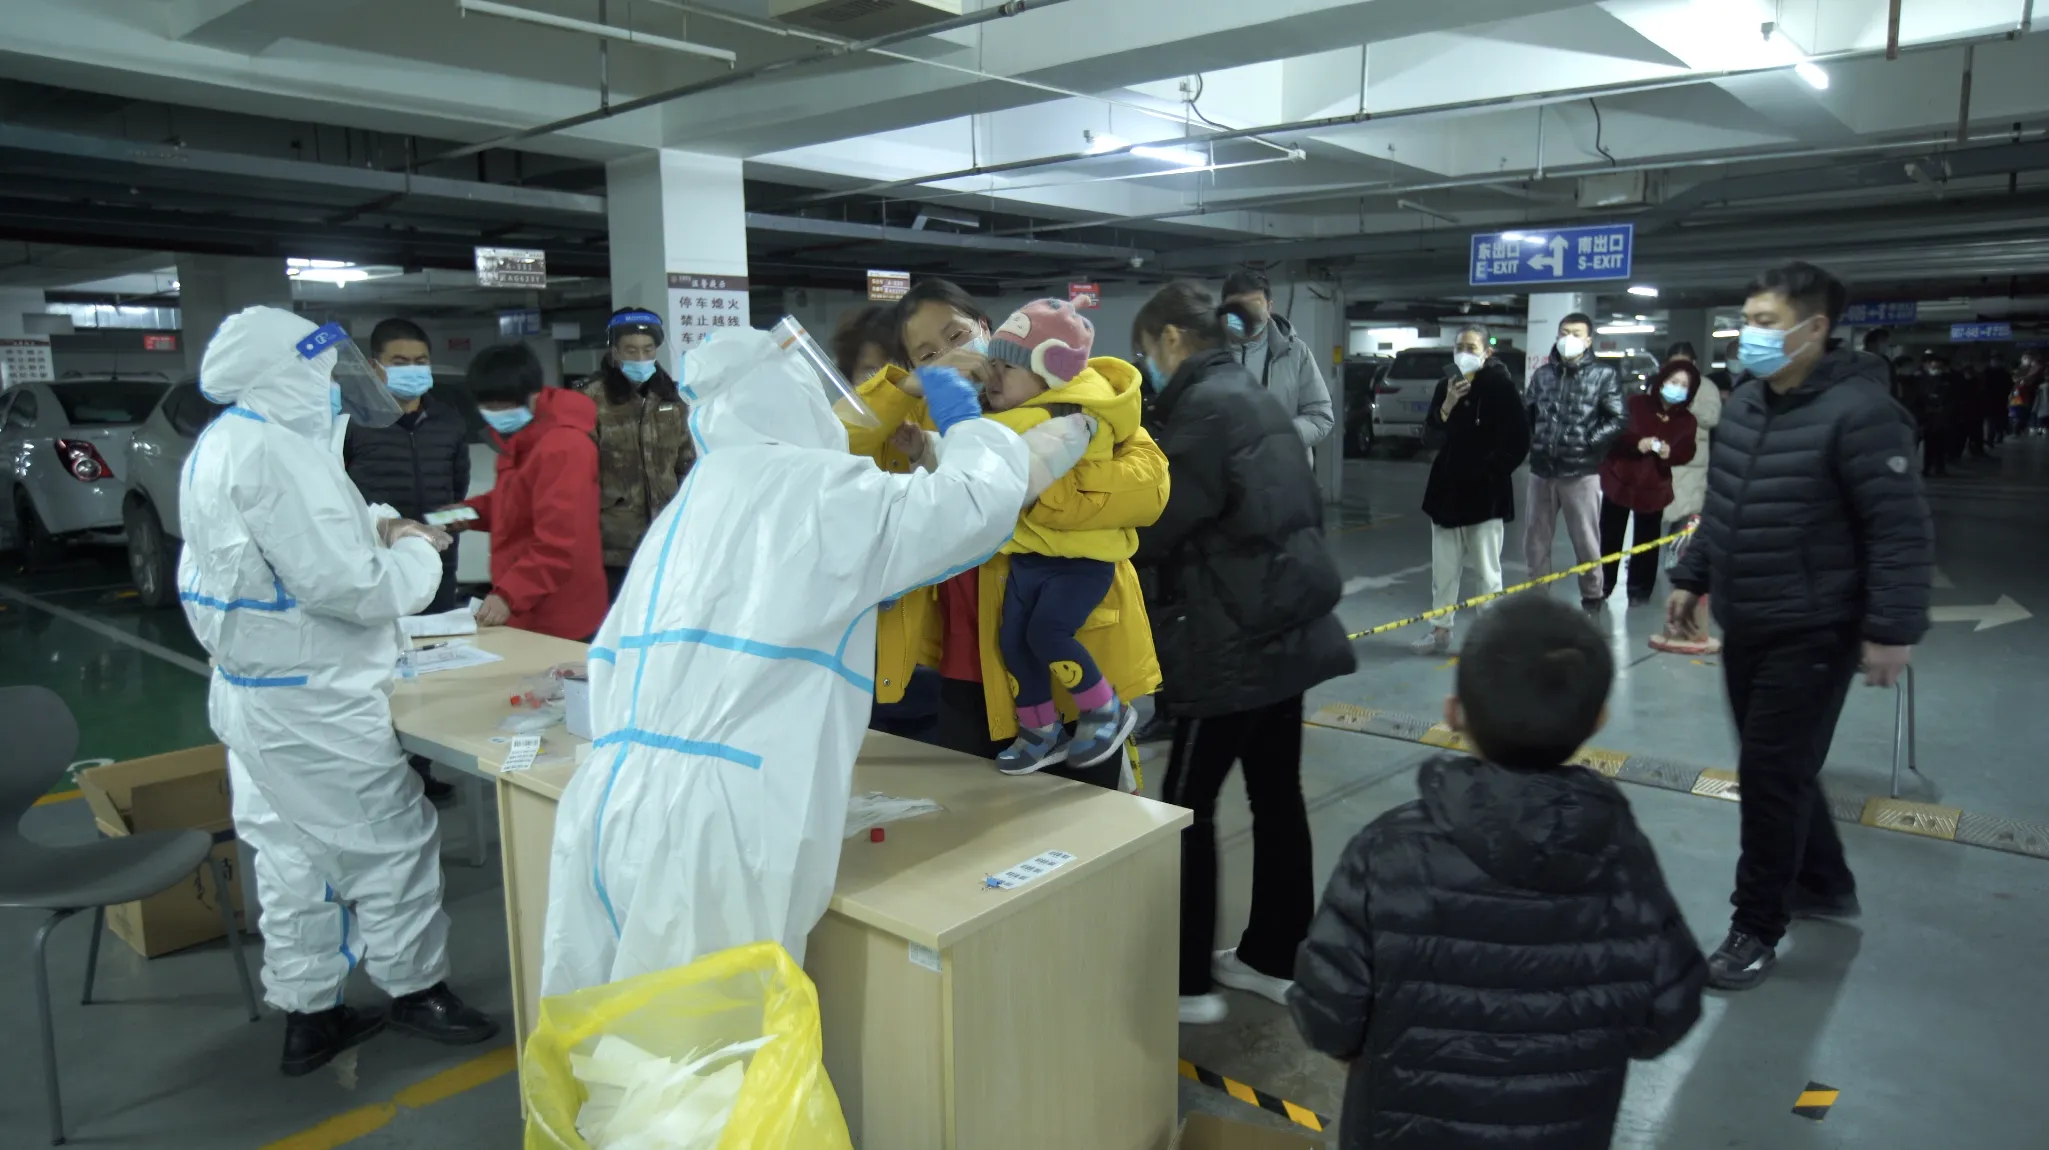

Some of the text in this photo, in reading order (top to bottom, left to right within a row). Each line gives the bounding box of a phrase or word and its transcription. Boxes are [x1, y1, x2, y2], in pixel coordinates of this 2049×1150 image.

[1478, 242, 1520, 260] 东出口
[1578, 234, 1624, 254] 南出口
[1475, 260, 1519, 280] E-EXIT
[1578, 254, 1624, 270] S-EXIT
[679, 296, 740, 310] 停车熄火
[681, 314, 740, 327] 禁止越线
